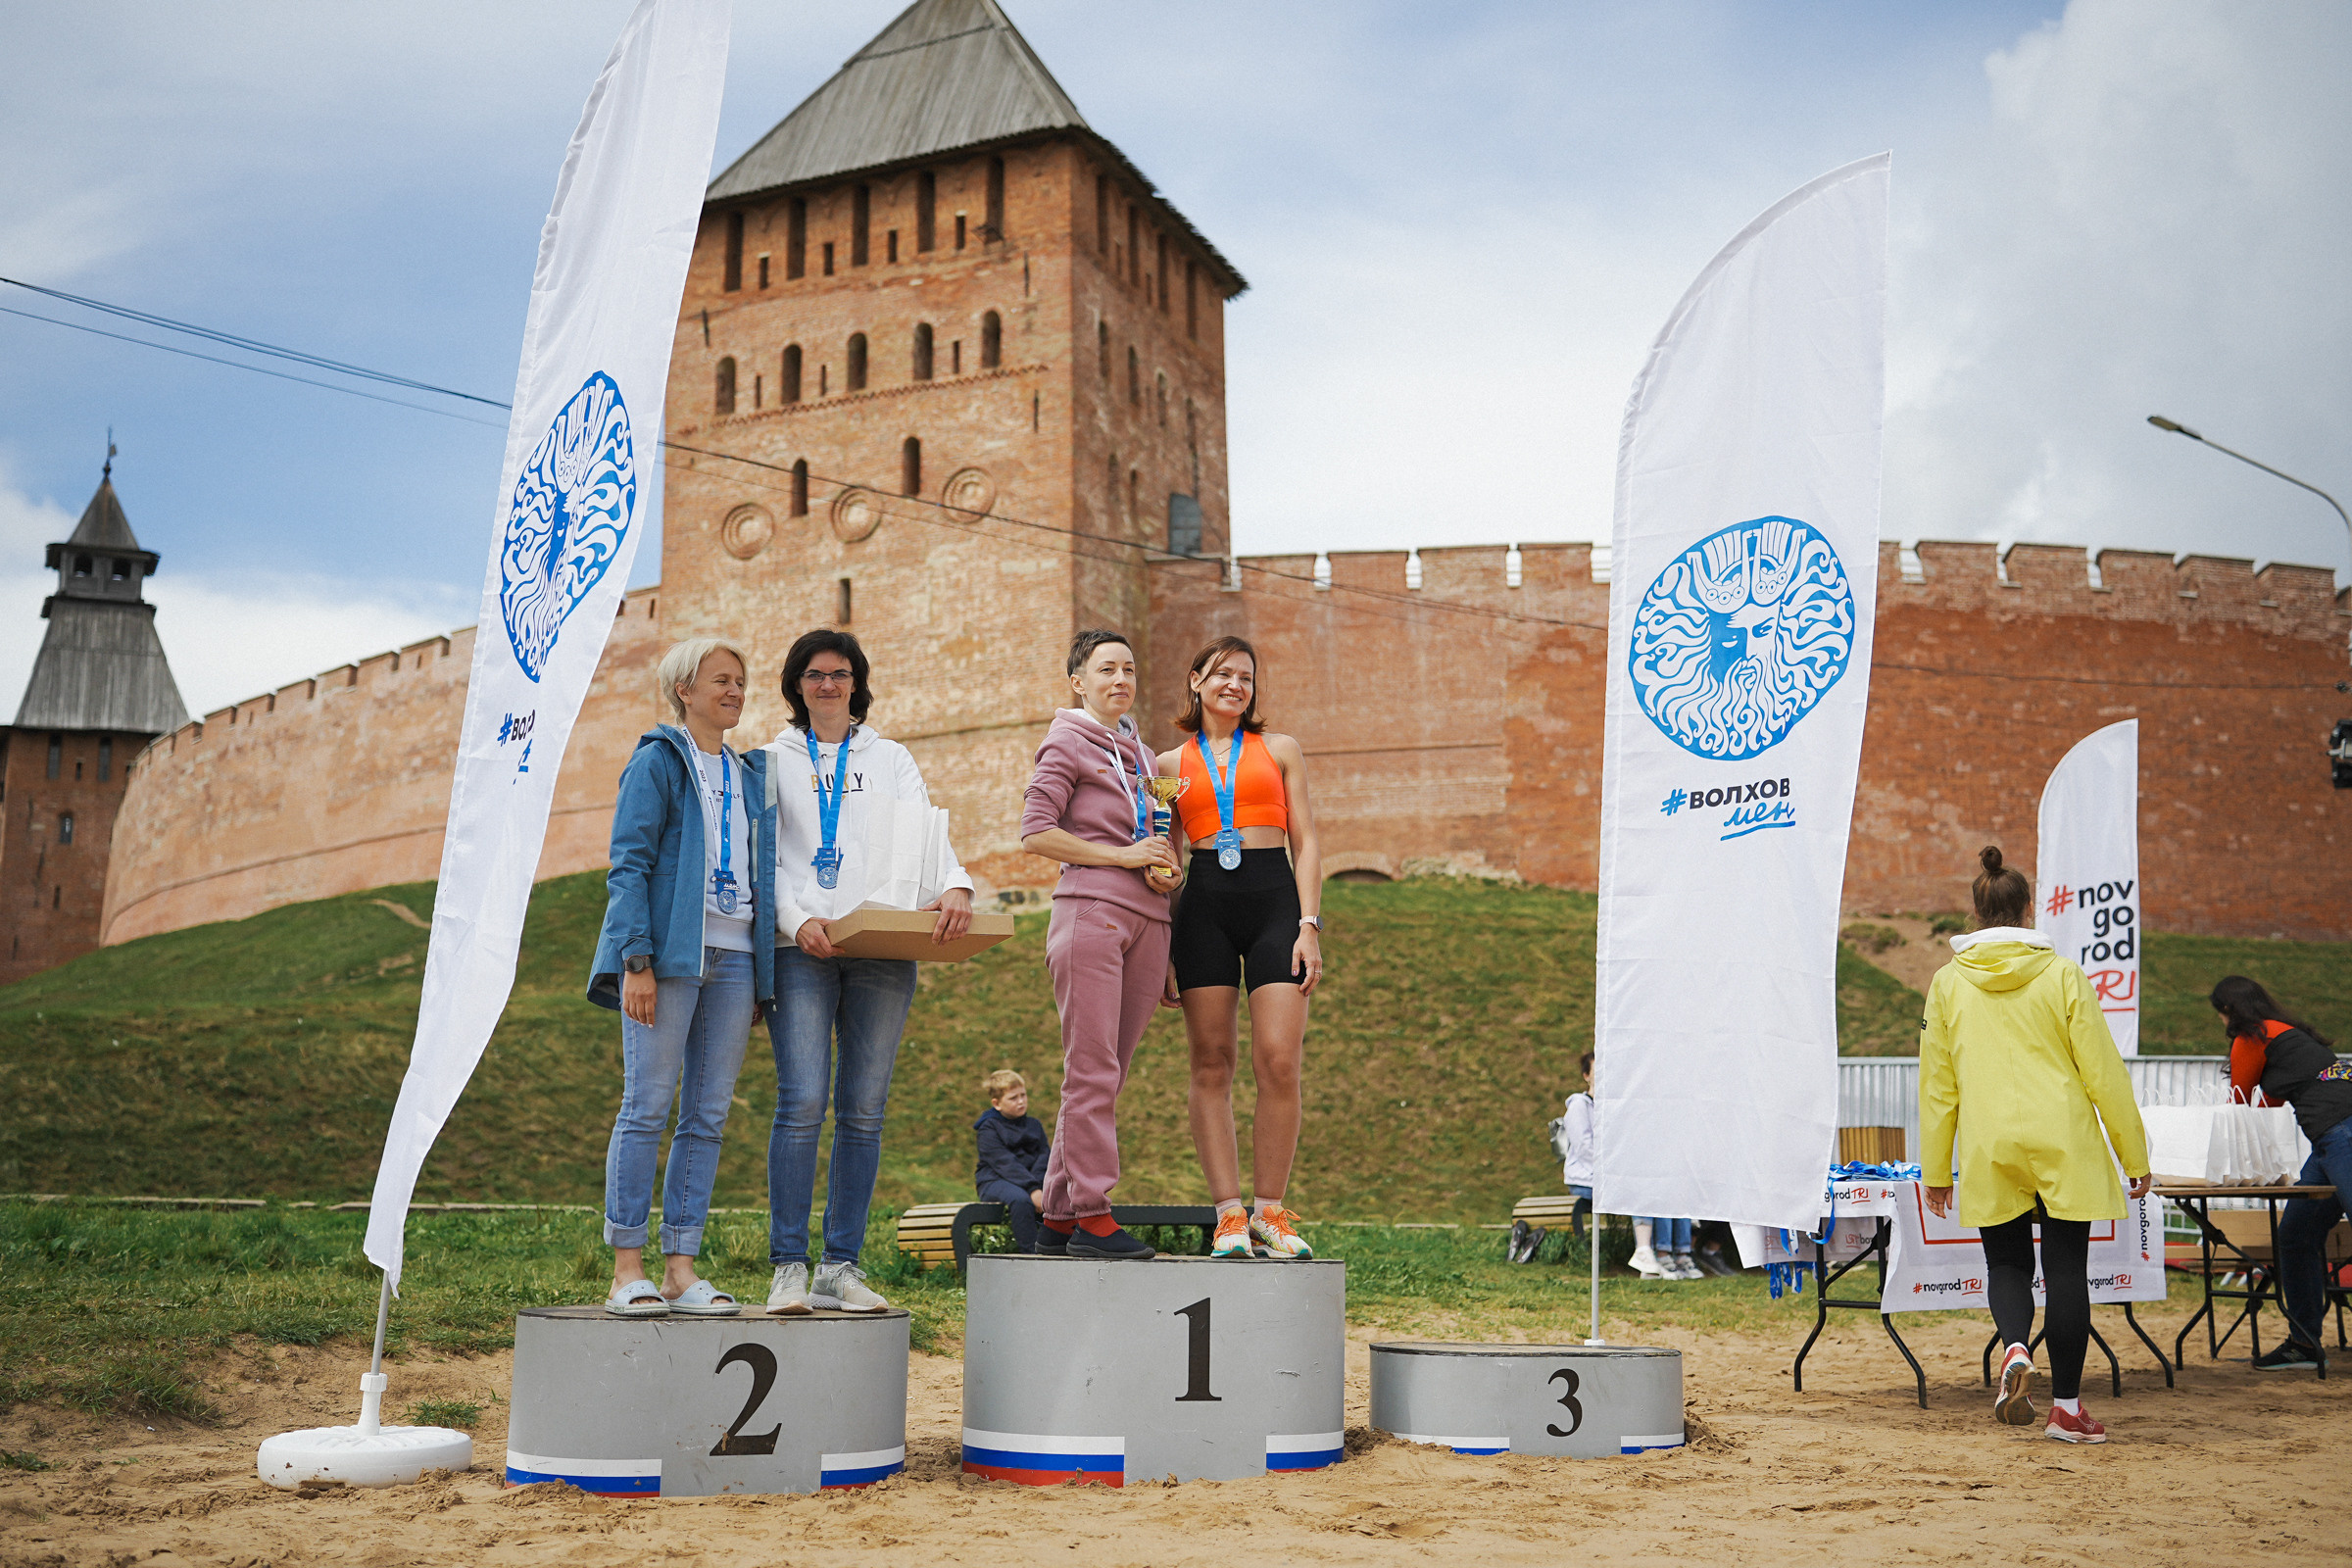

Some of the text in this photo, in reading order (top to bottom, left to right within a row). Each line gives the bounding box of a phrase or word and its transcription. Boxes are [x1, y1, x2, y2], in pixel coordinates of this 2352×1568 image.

[1660, 777, 1790, 816] #ВОЛХОВ
[1723, 801, 1795, 827] мен
[2046, 880, 2134, 916] #nov
[2093, 906, 2134, 938] go
[2082, 927, 2134, 965] rod
[1173, 1297, 1222, 1401] 1
[709, 1343, 783, 1457] 2
[1546, 1368, 1583, 1438] 3
